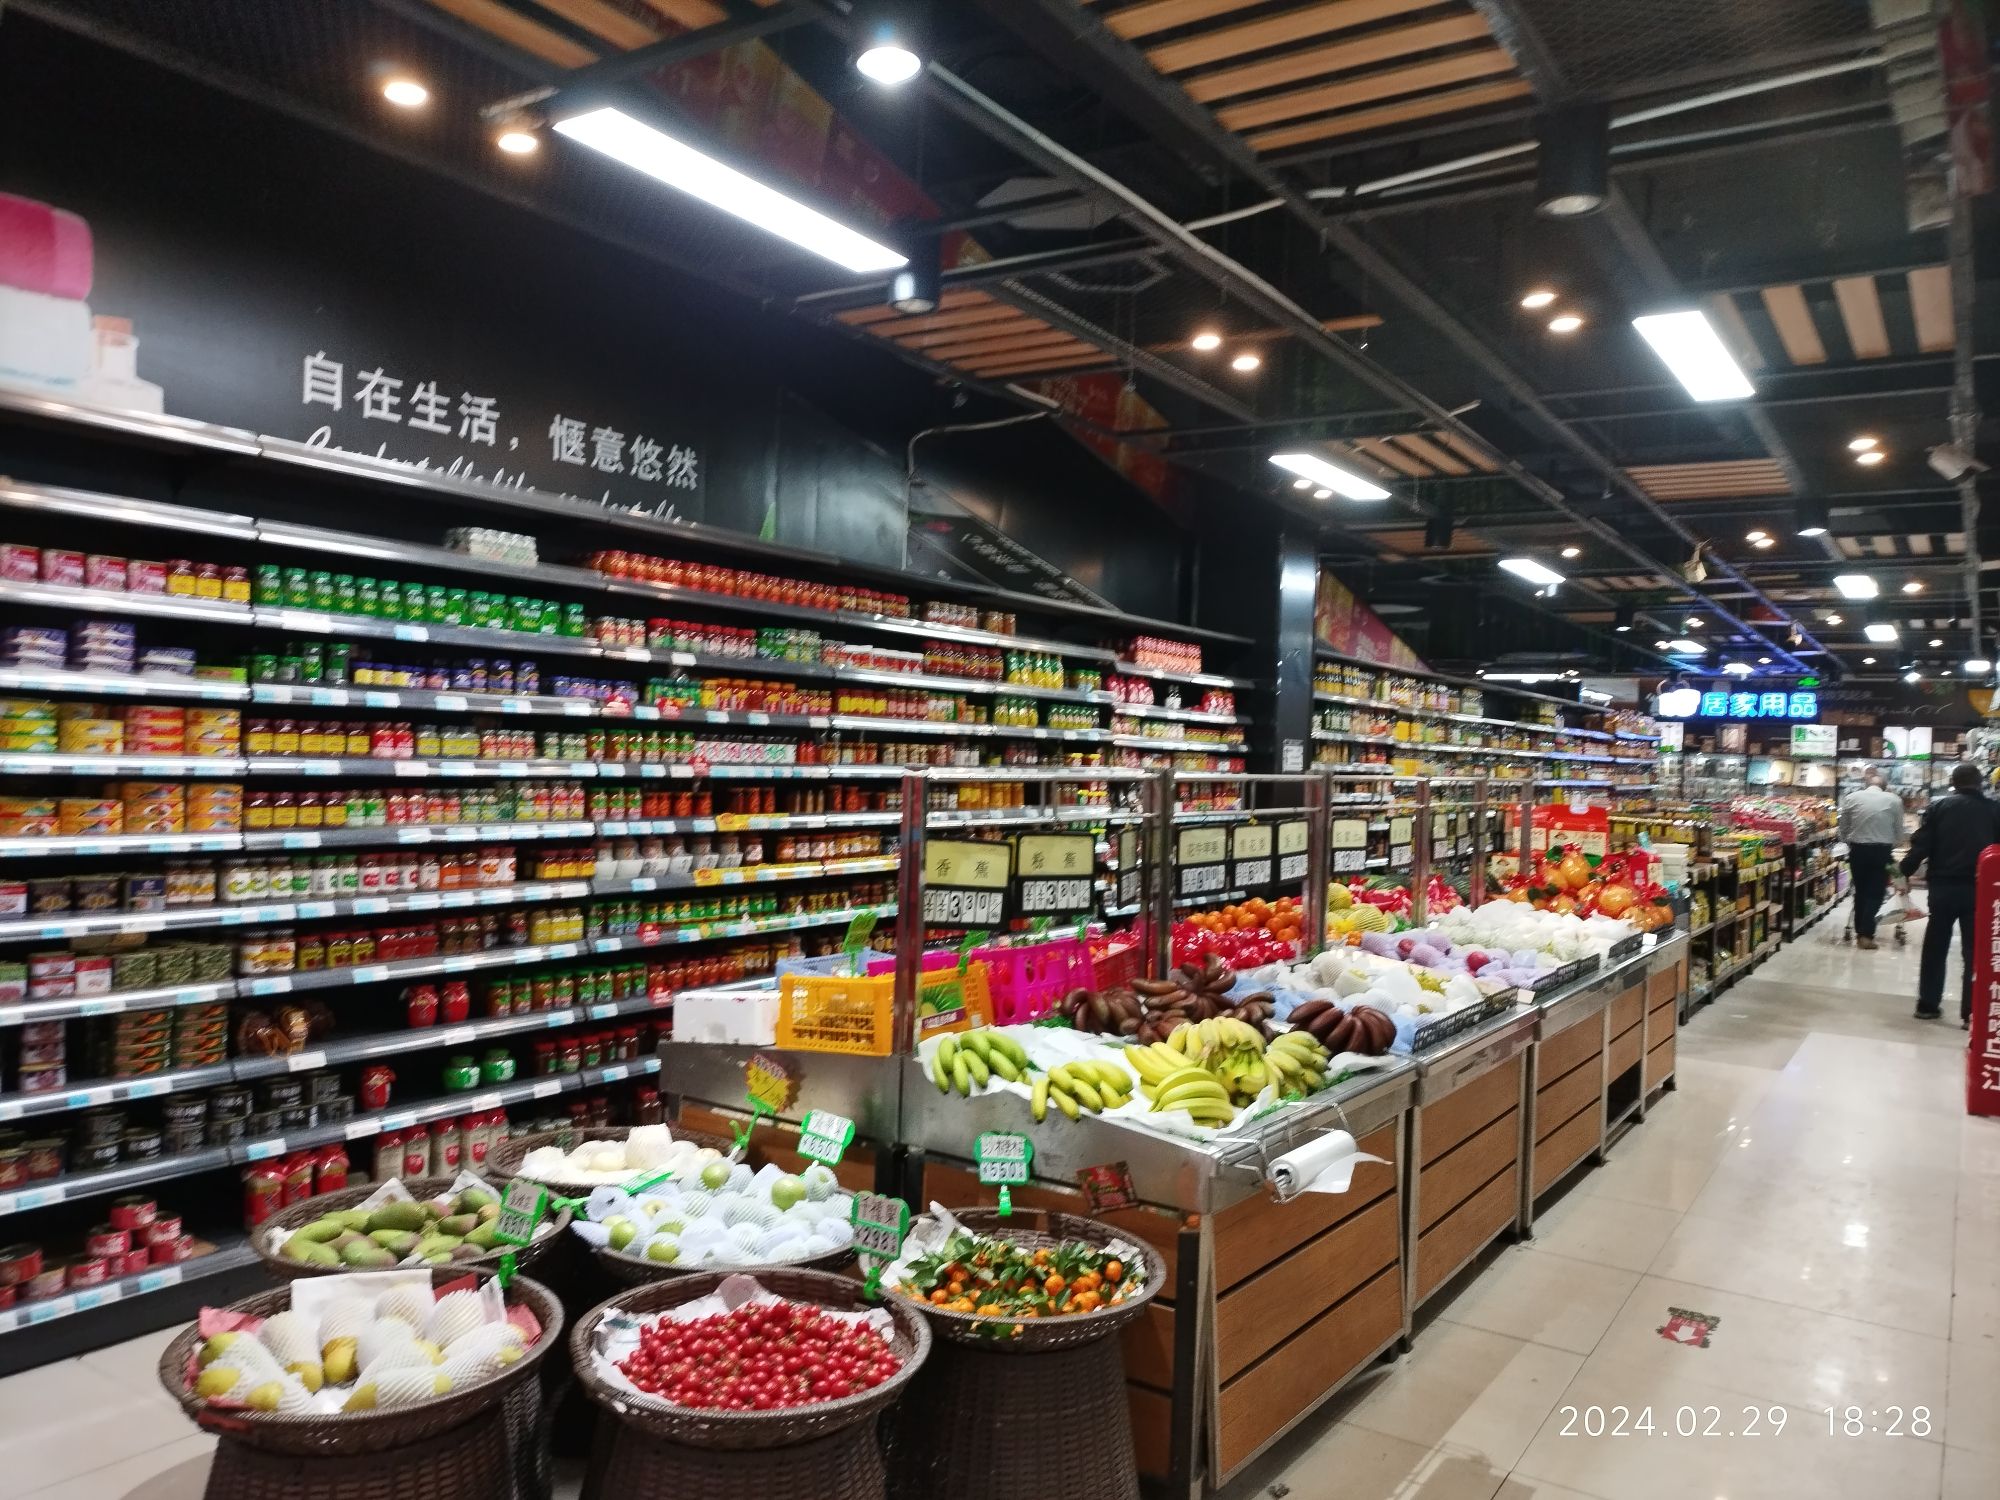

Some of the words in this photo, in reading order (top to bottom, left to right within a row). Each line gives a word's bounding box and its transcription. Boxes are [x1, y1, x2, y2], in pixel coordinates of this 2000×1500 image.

[1700, 692, 1817, 717] 居家用品
[936, 858, 989, 880] 香蕉
